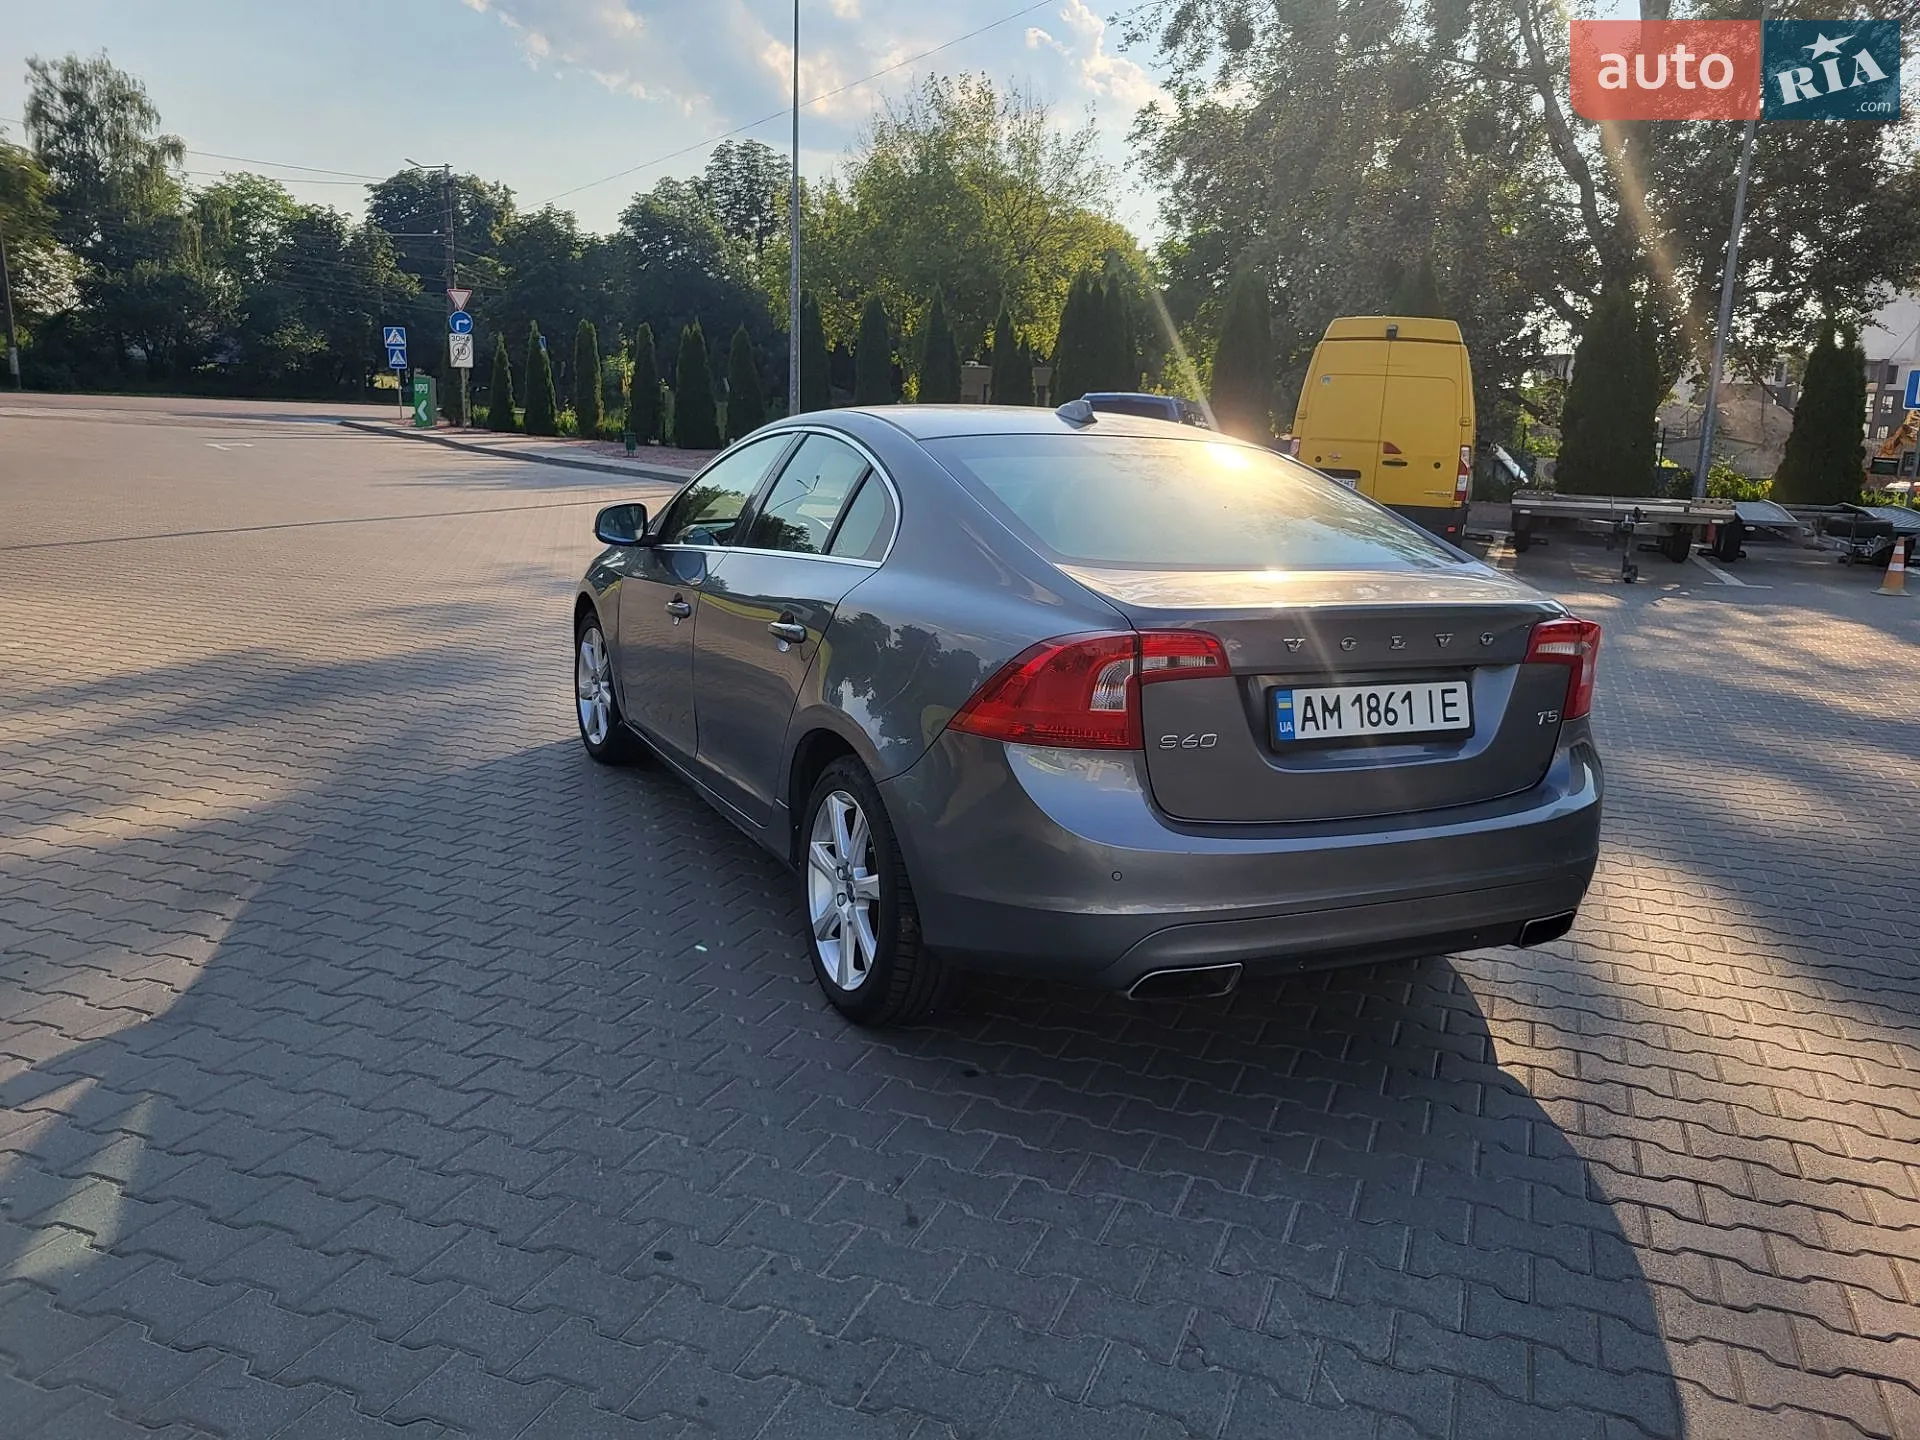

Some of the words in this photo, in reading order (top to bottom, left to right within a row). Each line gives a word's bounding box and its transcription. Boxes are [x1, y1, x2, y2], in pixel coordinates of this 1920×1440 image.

[1282, 631, 1494, 652] VOLVO
[1301, 693, 1342, 731] AM
[1350, 689, 1414, 728] 1861
[1428, 688, 1460, 723] IE
[1537, 710, 1558, 725] T5
[1279, 721, 1294, 733] UA
[1160, 733, 1218, 749] S60
